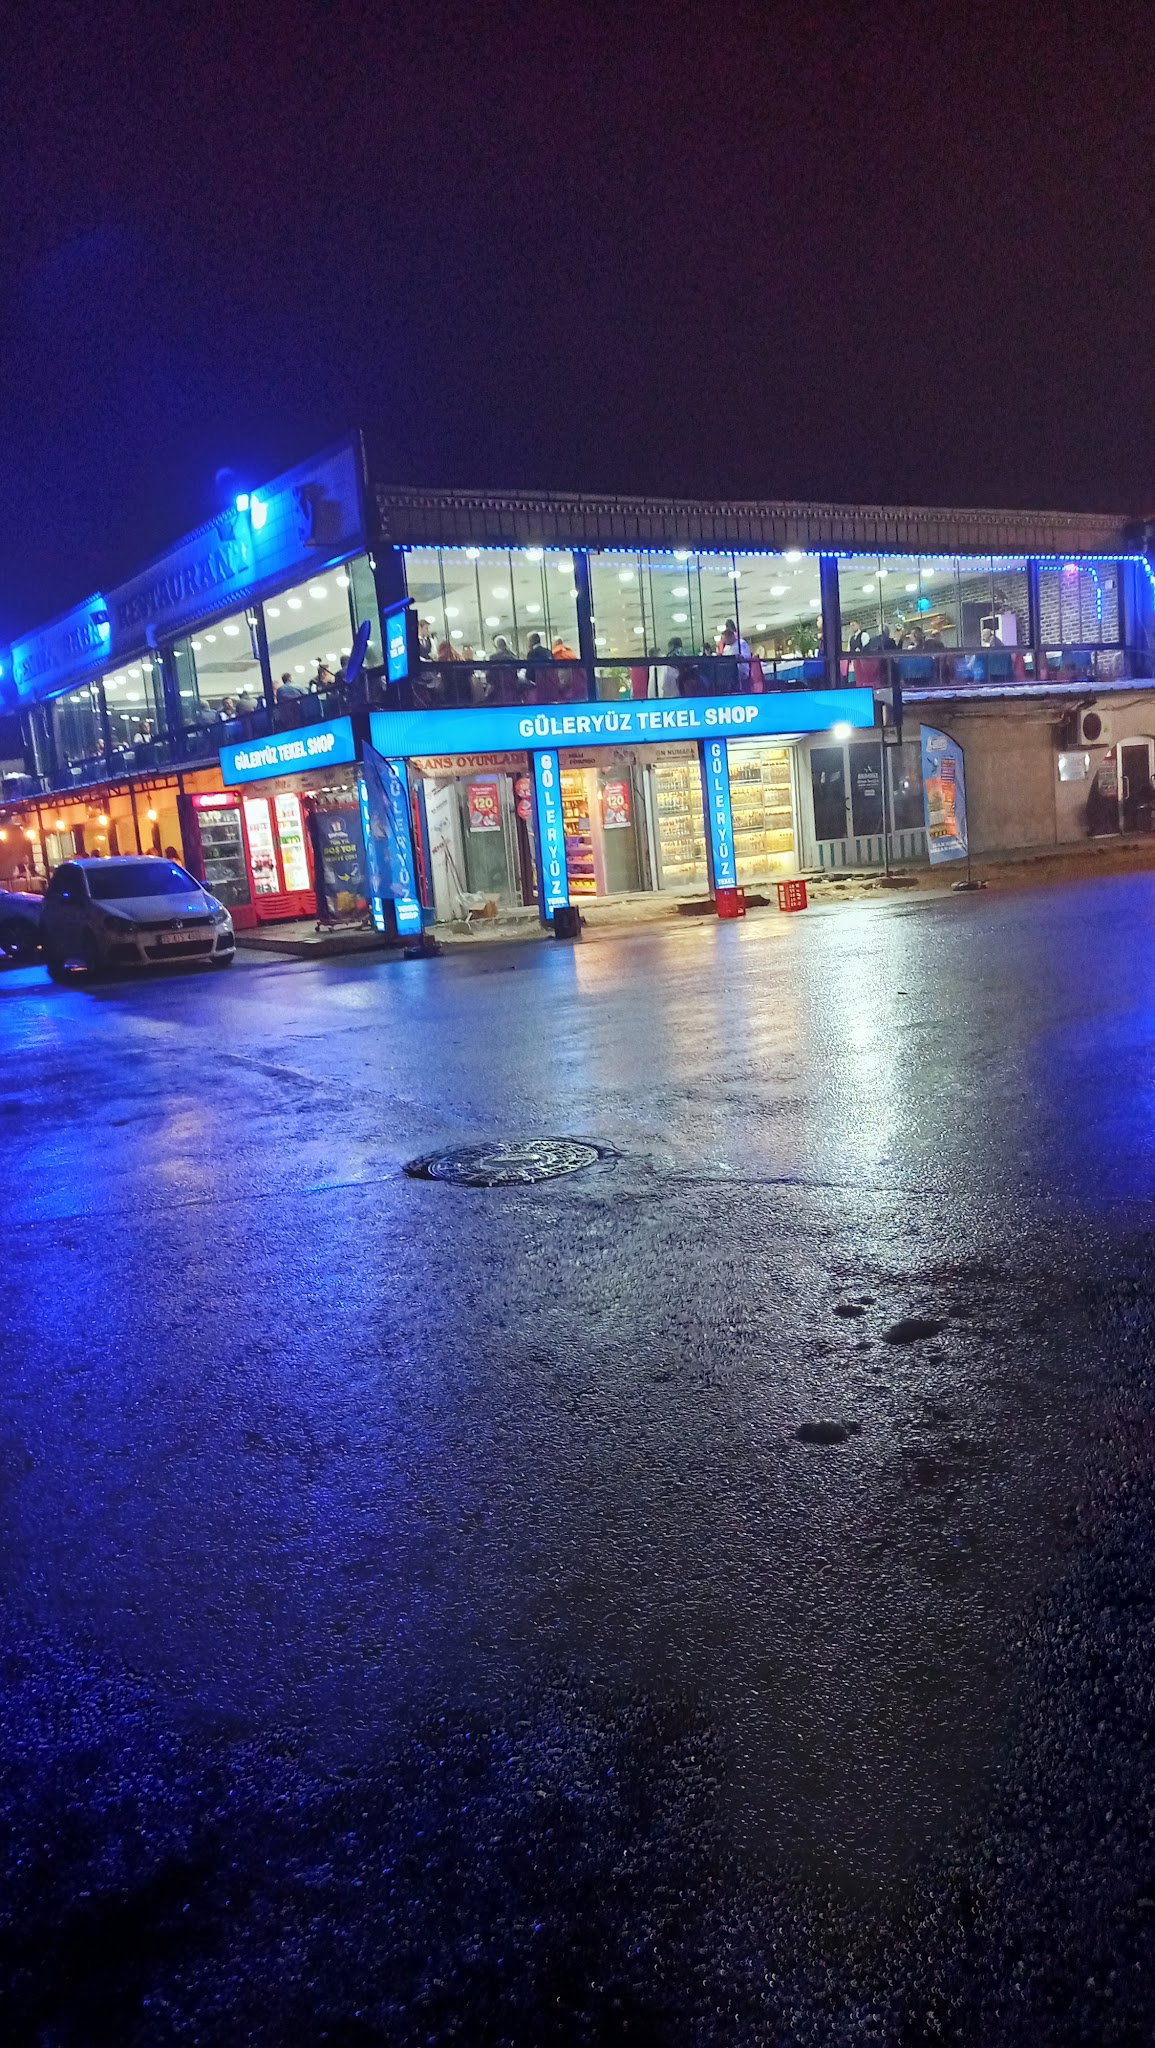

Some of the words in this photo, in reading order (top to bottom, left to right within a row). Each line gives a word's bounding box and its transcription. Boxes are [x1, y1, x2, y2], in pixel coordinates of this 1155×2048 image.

[519, 710, 632, 738] GÜLERYÜZ
[635, 709, 701, 730] TEKEL
[704, 705, 759, 726] SHOP
[234, 745, 279, 771] GÜLERYÜZ
[277, 740, 308, 762] TEKEL
[307, 733, 335, 756] SHOP
[474, 797, 494, 809] 120
[606, 795, 625, 808] 120
[710, 743, 730, 876] GÜLERYÜZ
[540, 754, 562, 895] GÜLERYÜZ
